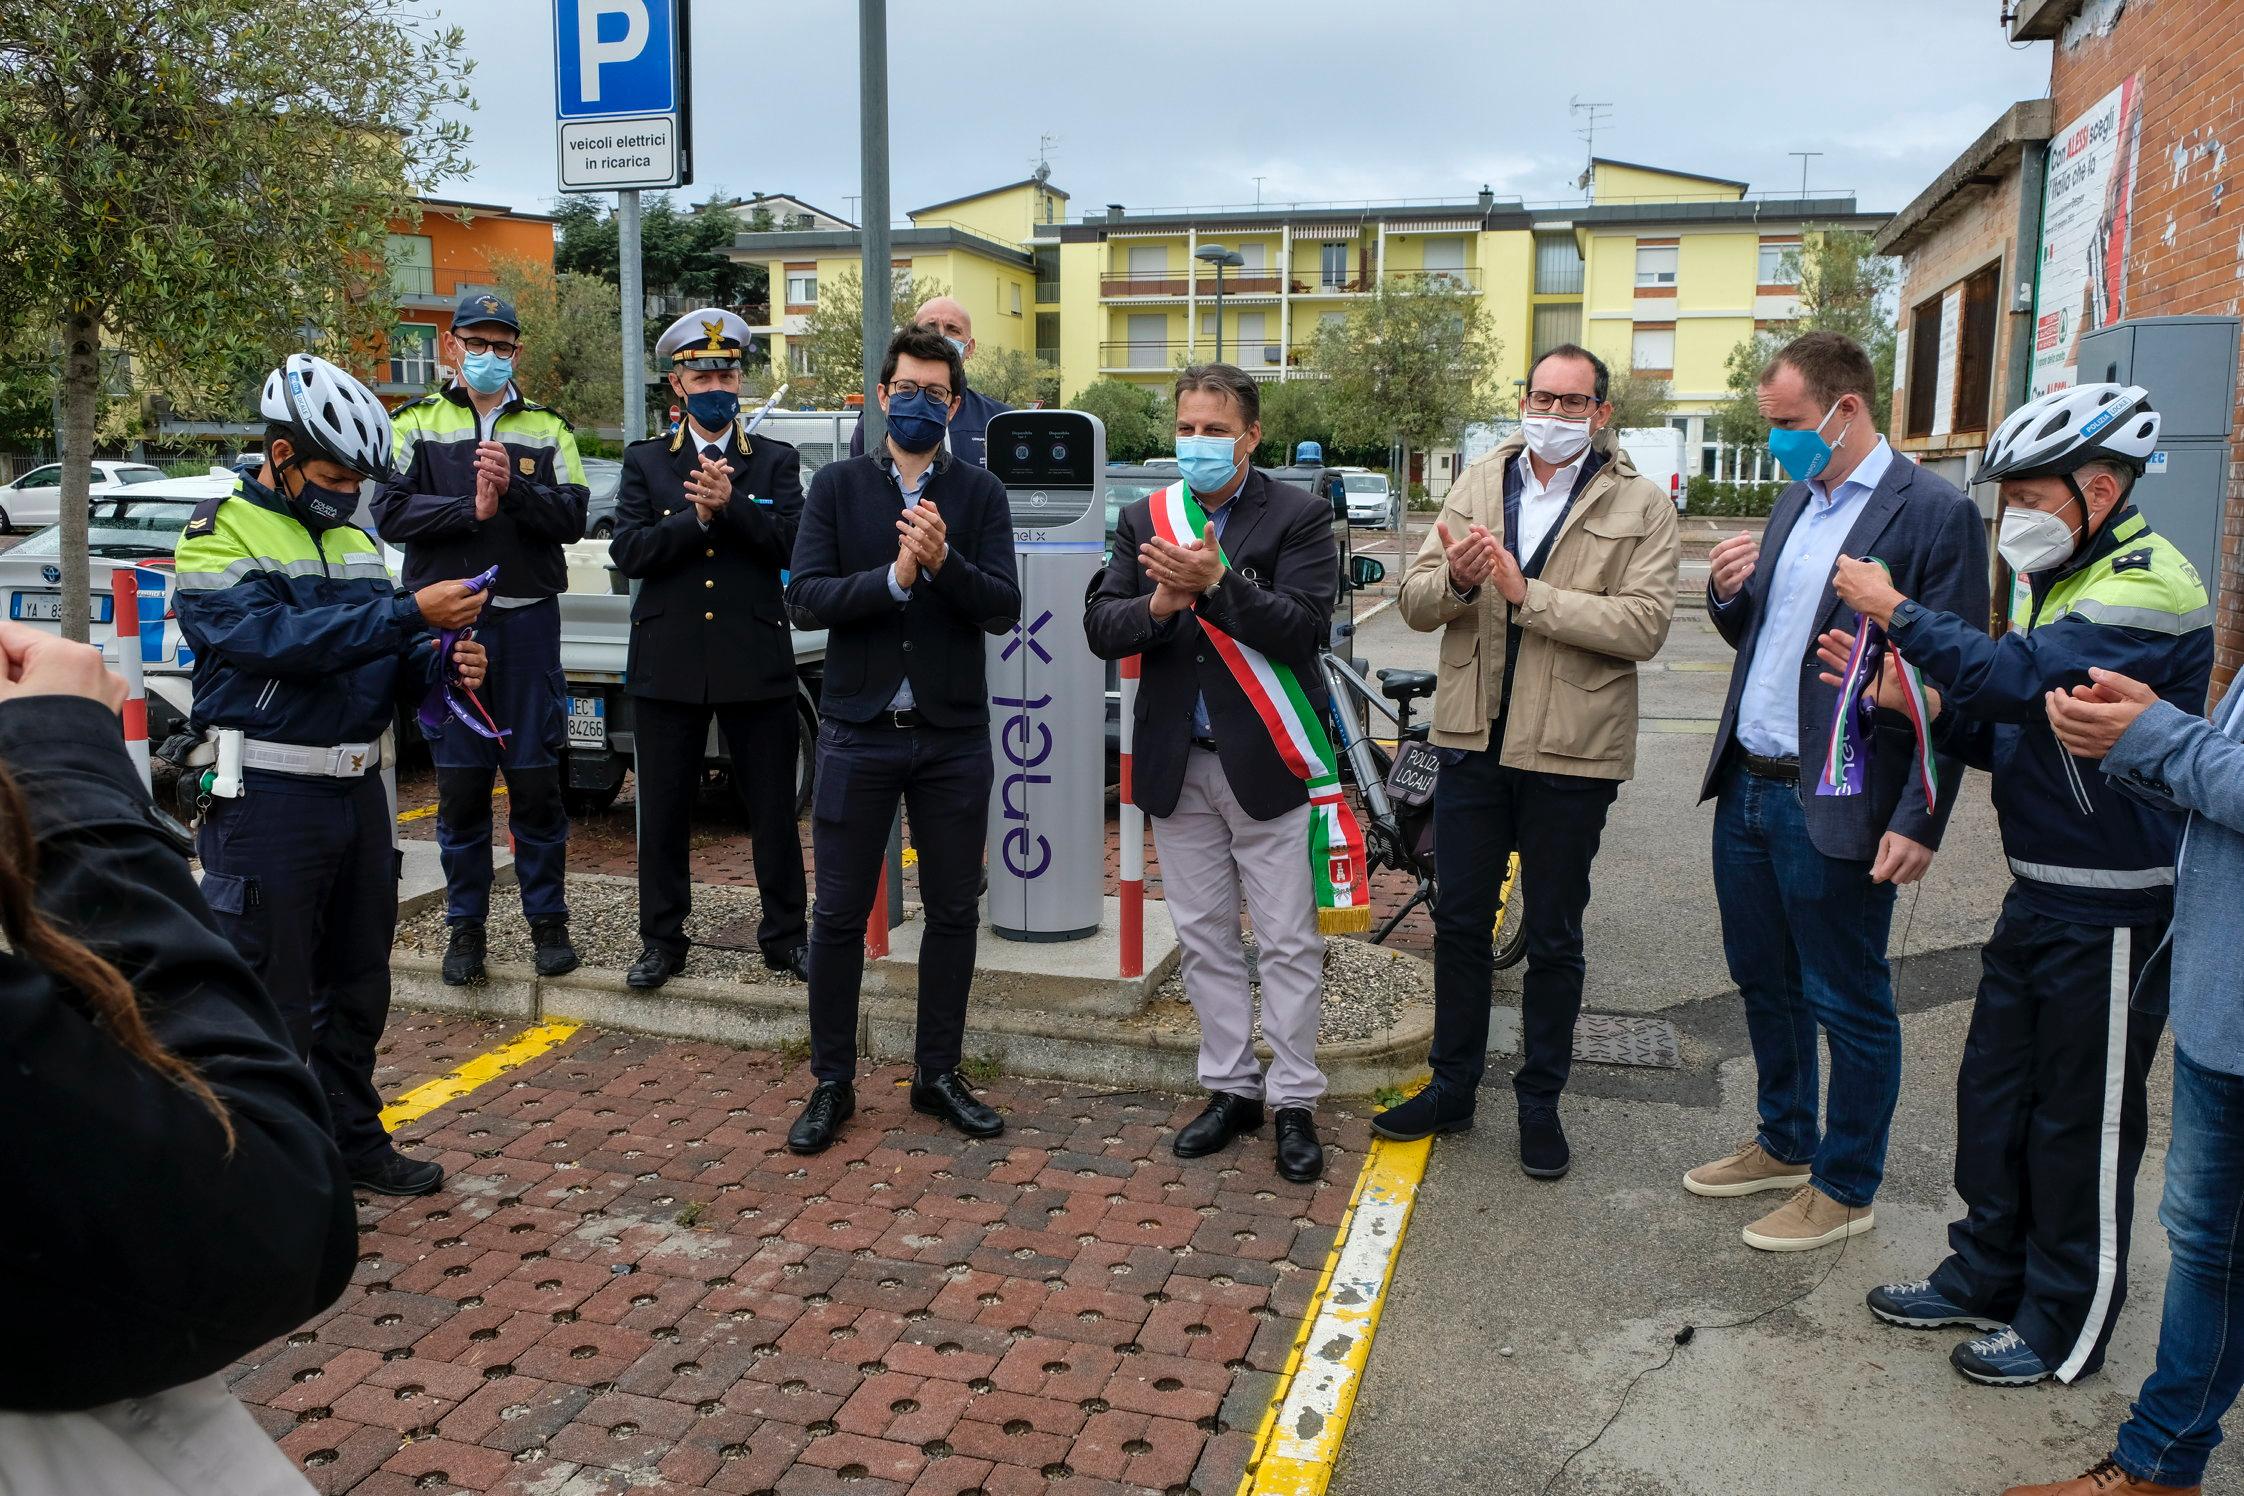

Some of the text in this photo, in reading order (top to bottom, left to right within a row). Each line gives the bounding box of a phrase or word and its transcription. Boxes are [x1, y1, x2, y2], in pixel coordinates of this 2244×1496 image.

[578, 0, 650, 103] P
[569, 133, 666, 151] veicoli elettrici
[2051, 105, 2115, 172] Con ALESSI scegli
[585, 156, 651, 170] in ricarica
[2071, 161, 2086, 188] che
[2087, 151, 2096, 176] la
[2086, 399, 2128, 433] POLIZIA LOCALE
[310, 503, 337, 518] LOCALE
[1012, 529, 1046, 541] nel x
[26, 603, 38, 618] YA
[575, 699, 589, 715] EC
[992, 609, 1054, 880] enel x
[1406, 749, 1440, 772] POLIZI
[1395, 767, 1433, 791] LOCALE
